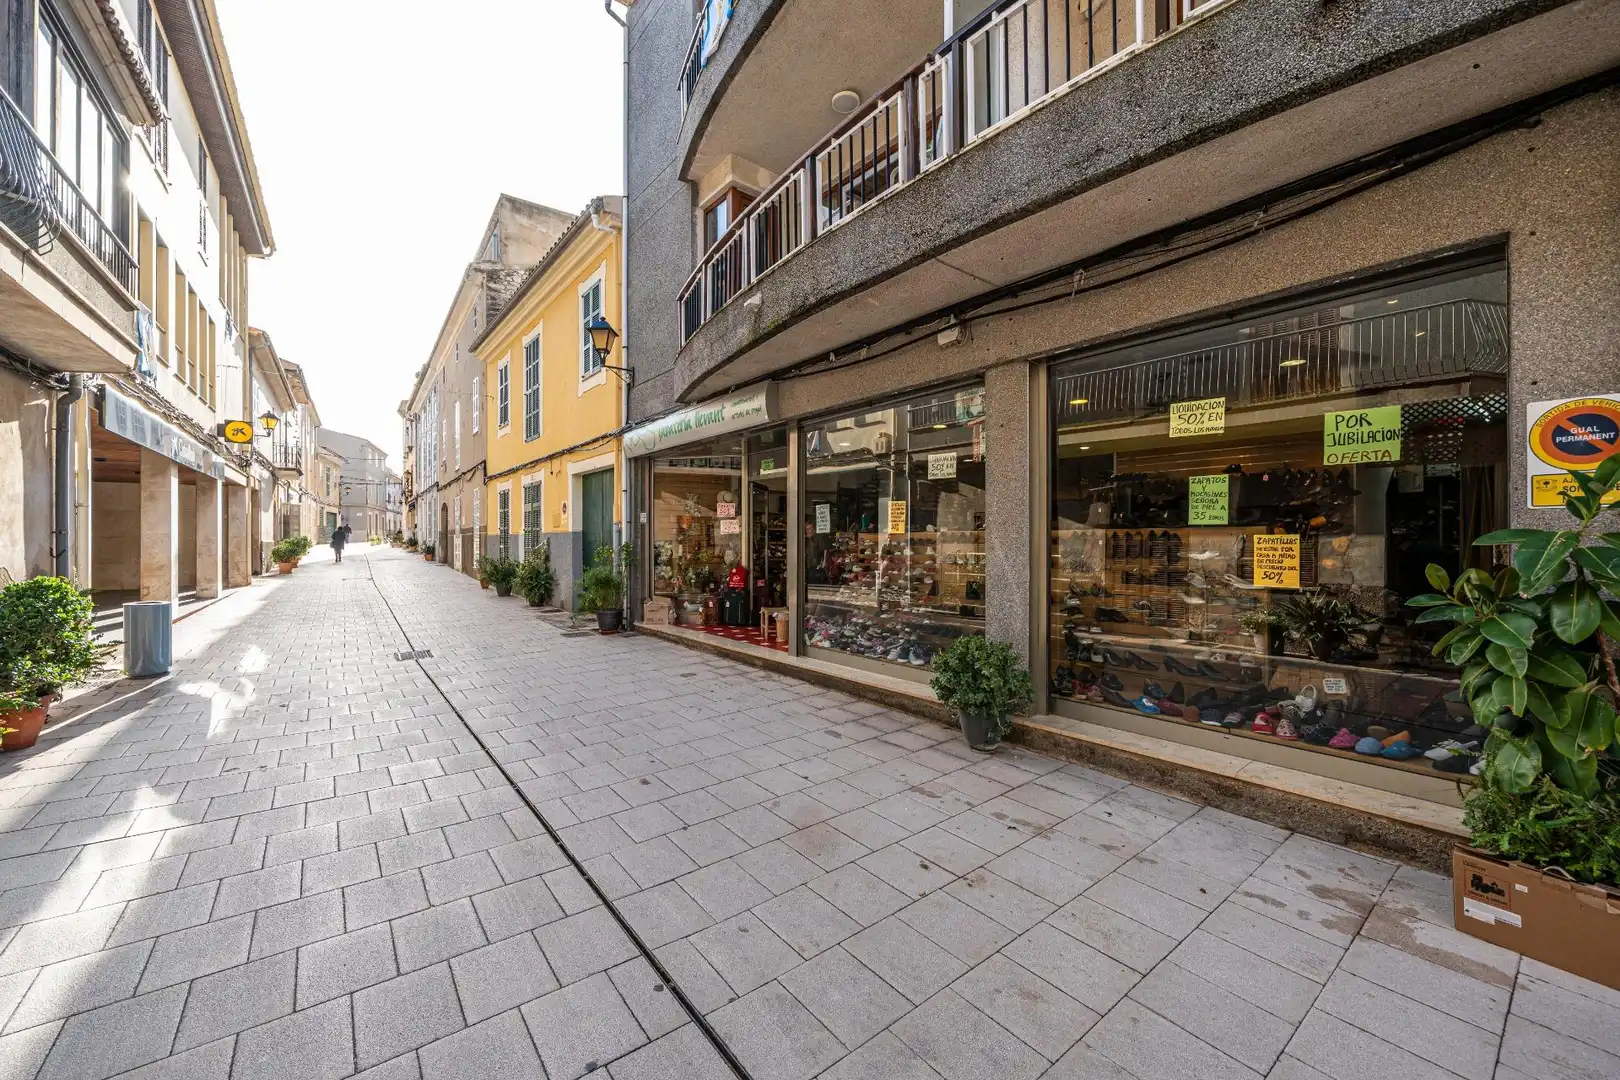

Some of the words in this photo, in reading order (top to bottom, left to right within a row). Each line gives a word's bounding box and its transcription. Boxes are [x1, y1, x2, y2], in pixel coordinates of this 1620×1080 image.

[1172, 401, 1224, 415] LIQUIDACION
[1177, 411, 1205, 426] 50%
[1208, 412, 1224, 422] EN
[1335, 413, 1372, 431] POR
[1535, 404, 1572, 429] SORTIDA
[1570, 425, 1600, 434] GUAL
[1556, 432, 1615, 443] PERMANENT
[1327, 449, 1392, 464] OFERTA
[1193, 512, 1206, 520] 35
[1257, 537, 1298, 545] ZAPATILLAS
[1261, 570, 1284, 584] 50%
